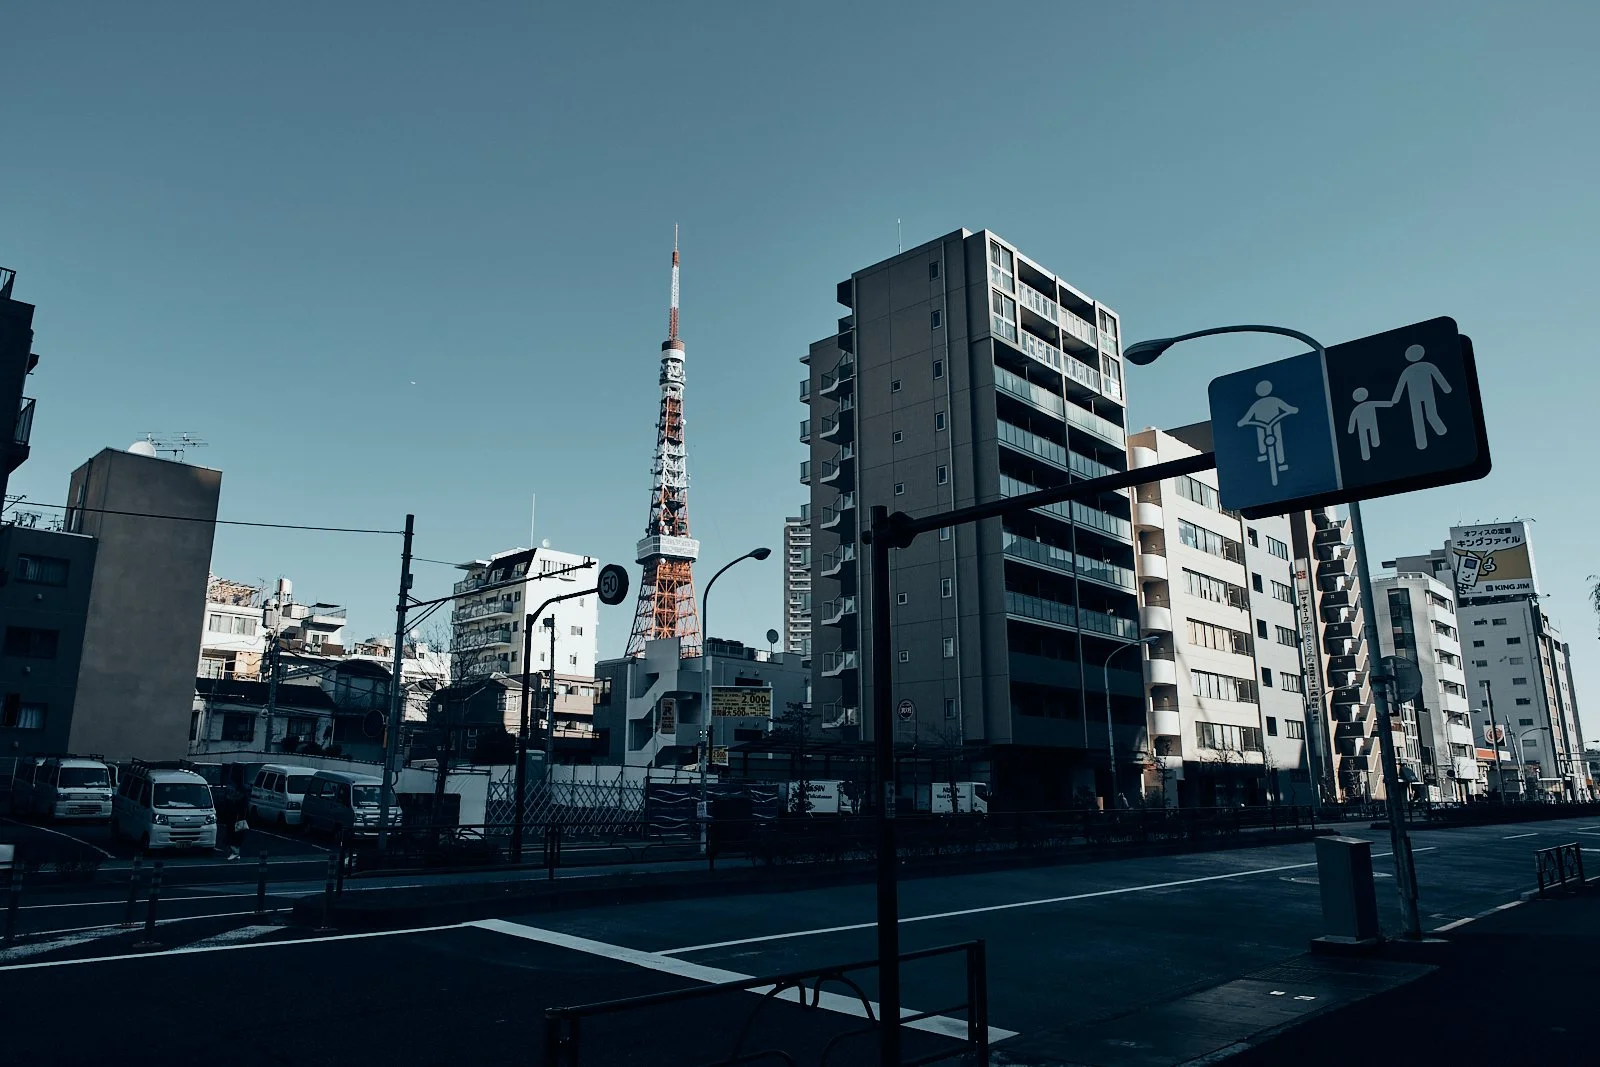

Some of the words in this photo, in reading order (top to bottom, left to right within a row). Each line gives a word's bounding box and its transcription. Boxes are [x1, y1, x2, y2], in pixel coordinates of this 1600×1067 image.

[1464, 527, 1512, 537] オフィスの定番
[1457, 536, 1520, 547] キングファイル
[603, 575, 617, 593] 50
